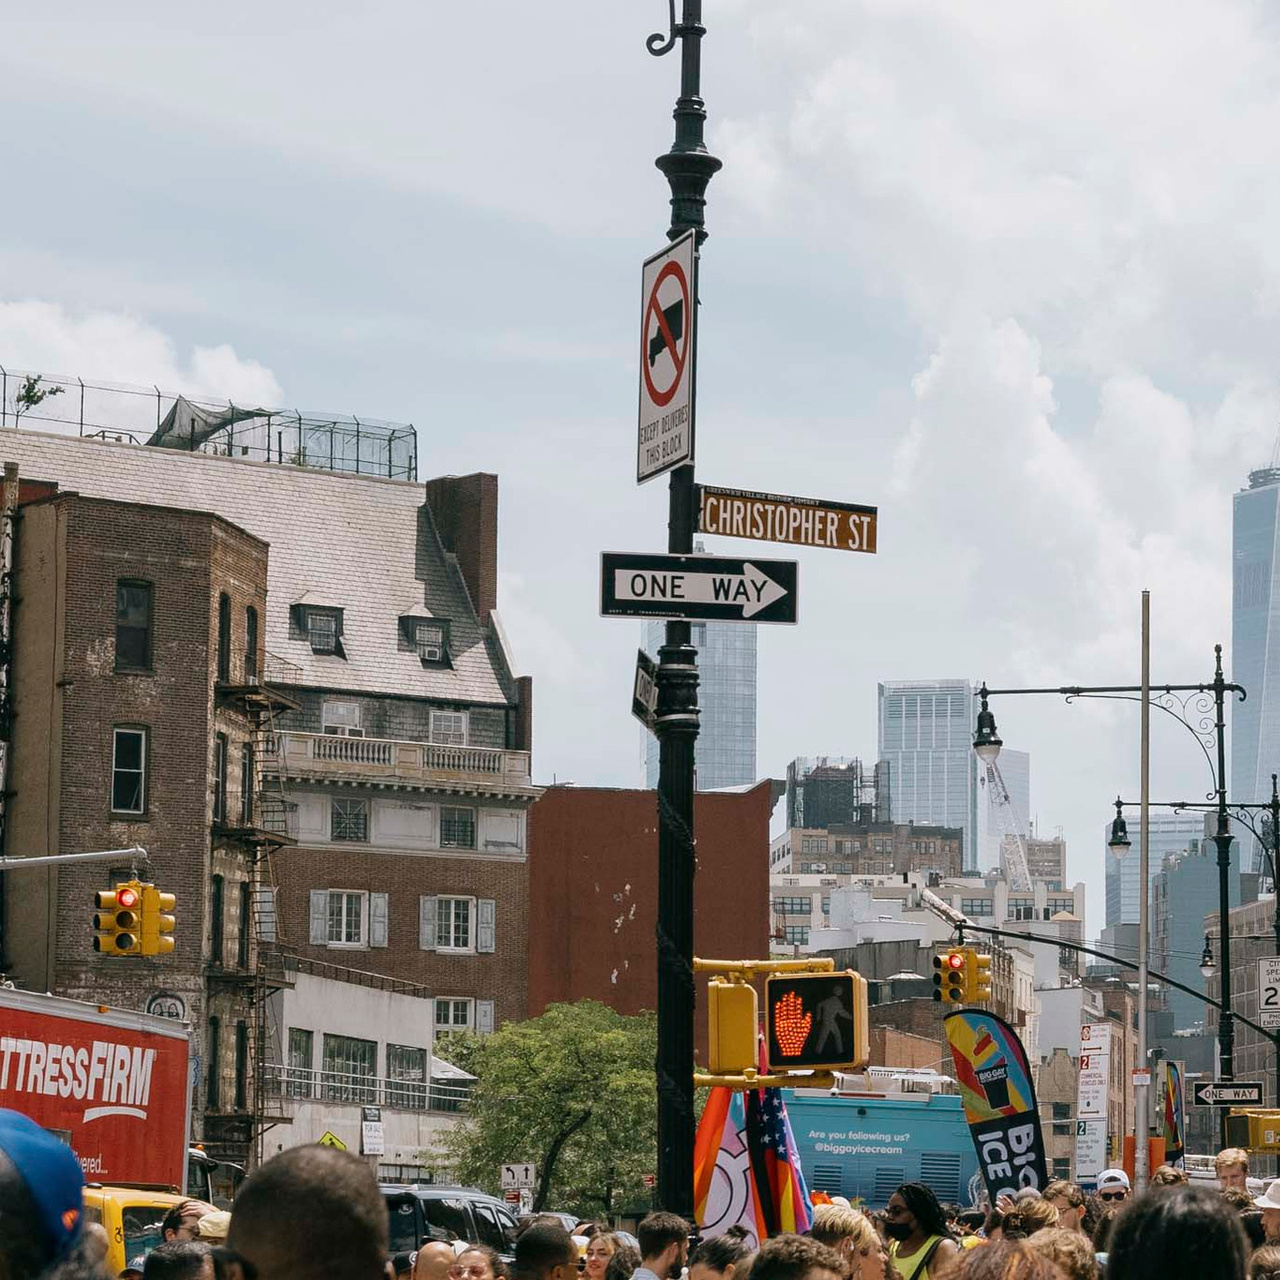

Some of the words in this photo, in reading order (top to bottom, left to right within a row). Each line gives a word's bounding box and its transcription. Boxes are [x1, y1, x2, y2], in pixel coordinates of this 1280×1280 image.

[640, 420, 660, 445] EXCEPT
[662, 404, 688, 435] DELIVERIES
[646, 444, 660, 467] THIS
[662, 432, 682, 459] BLOCK
[741, 490, 766, 500] VILLAGE
[706, 497, 839, 546] CHRISTOPHER
[848, 514, 871, 551] ST
[631, 574, 685, 598] ONE
[713, 578, 768, 602] WAY
[979, 1070, 992, 1080] BIG
[1204, 1090, 1224, 1099] ONE
[1233, 1090, 1255, 1099] WAY
[809, 1130, 825, 1138] Are
[828, 1131, 846, 1141] you
[848, 1130, 891, 1142] following
[894, 1132, 910, 1142] us?
[815, 1142, 902, 1154] @biggayicecream
[978, 1131, 1012, 1181] ICE
